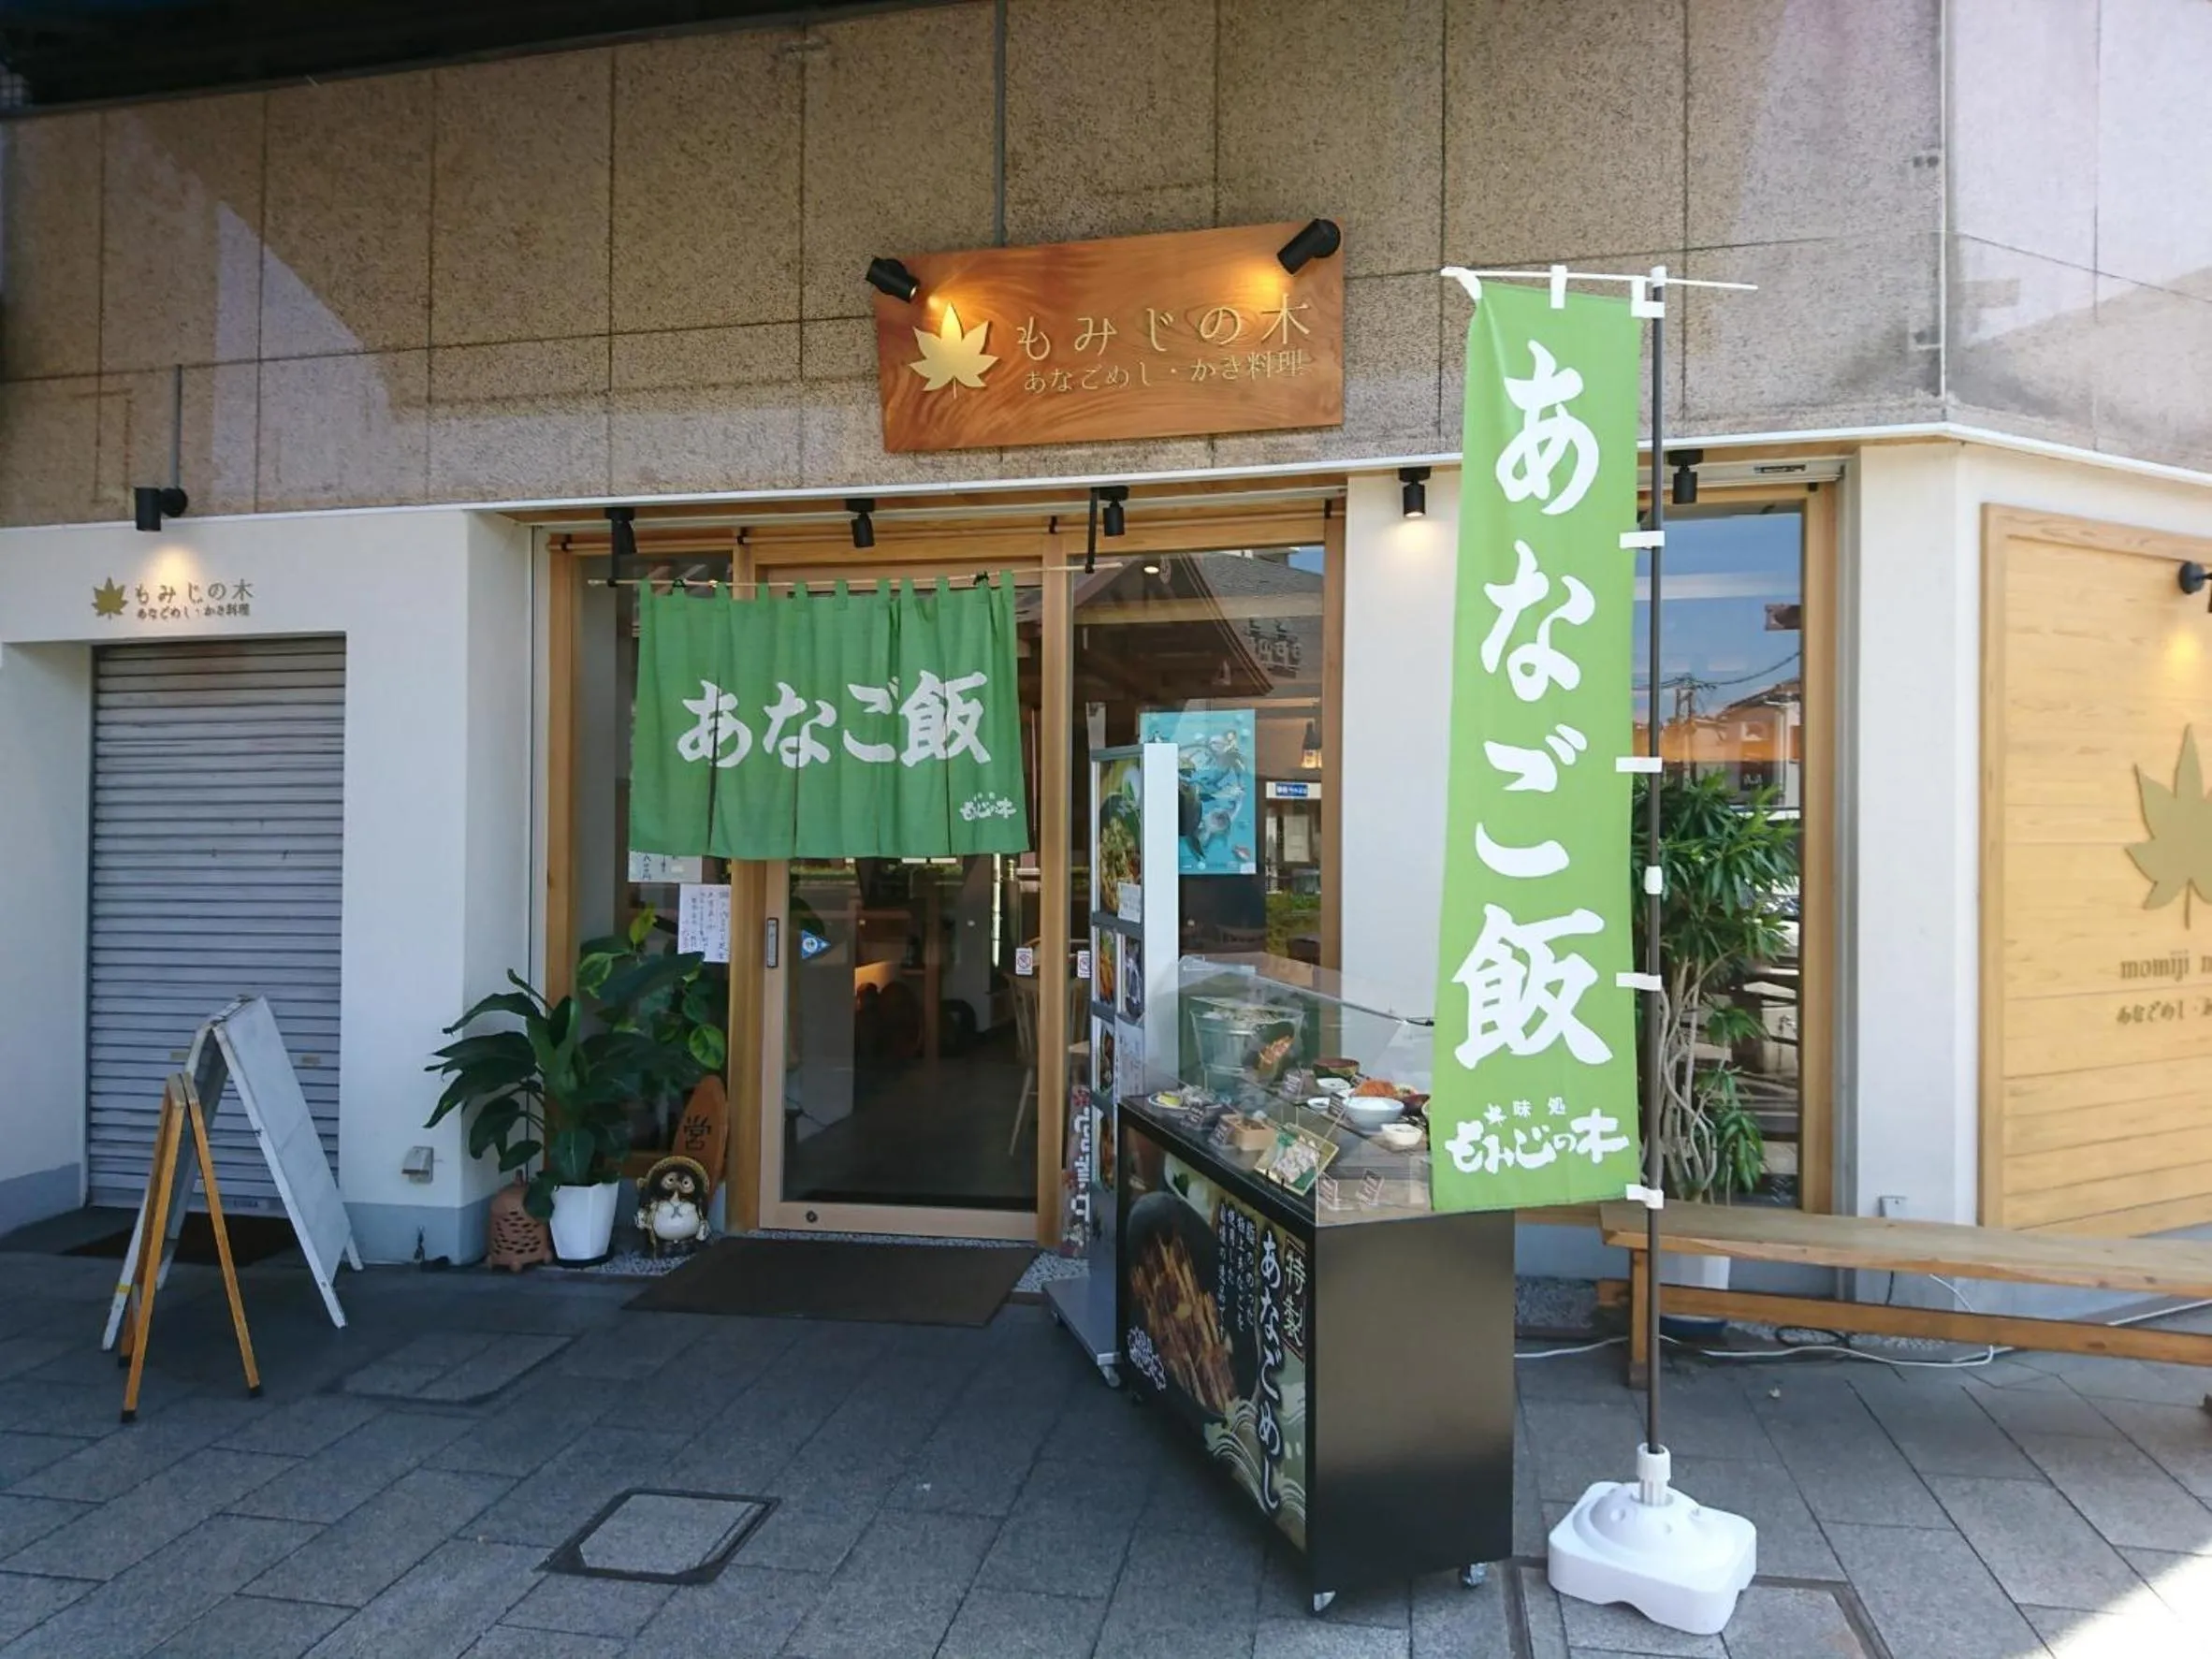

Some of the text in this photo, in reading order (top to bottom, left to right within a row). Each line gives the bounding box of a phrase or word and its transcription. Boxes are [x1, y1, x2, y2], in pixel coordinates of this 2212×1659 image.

[1016, 293, 1311, 361] もみじの木
[1024, 348, 1303, 394] あなごめし・かき料理
[135, 578, 254, 604] もみじの木
[677, 669, 992, 768] あなご飯
[1451, 340, 1614, 1070] あなご飯
[2119, 949, 2190, 982] momiji
[1512, 1096, 1566, 1117] 味処
[1259, 1230, 1282, 1509] あなごめし
